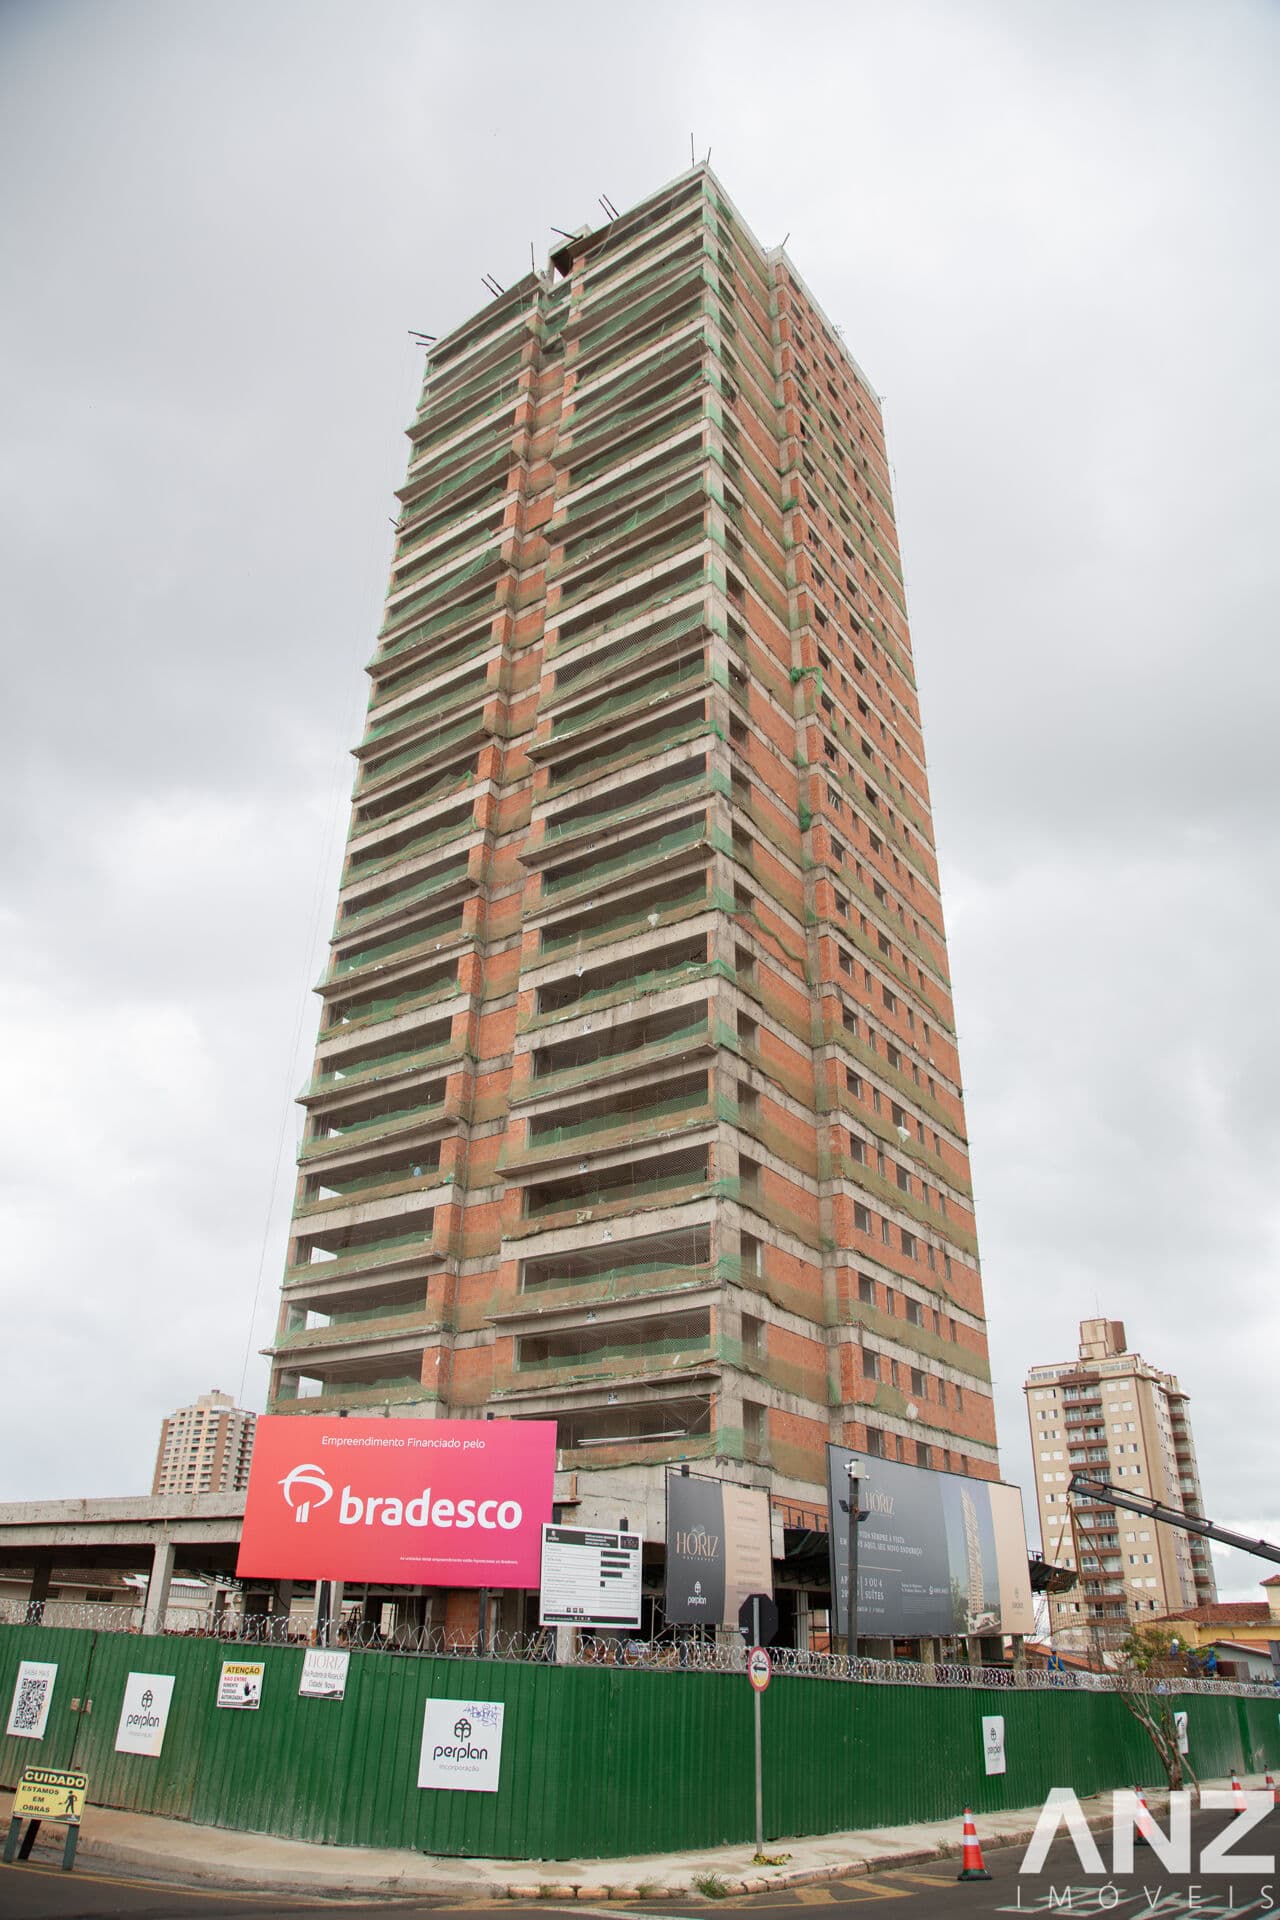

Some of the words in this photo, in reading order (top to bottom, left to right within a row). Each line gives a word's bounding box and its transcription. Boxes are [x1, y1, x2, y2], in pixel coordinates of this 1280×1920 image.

[321, 1435, 405, 1449] Empreendimento
[407, 1437, 461, 1449] Financiado
[463, 1438, 486, 1450] pelo
[339, 1485, 523, 1530] bradesco
[864, 1491, 895, 1514] HORIZ
[676, 1531, 720, 1557] HORIZ
[869, 1578, 878, 1587] OU
[226, 1665, 260, 1675] ATENÇÃO
[126, 1711, 160, 1729] perplan
[433, 1742, 488, 1762] perplan
[25, 1771, 85, 1788] CUIDADO
[22, 1785, 59, 1795] ESTAMOS
[22, 1804, 50, 1813] OBRAS
